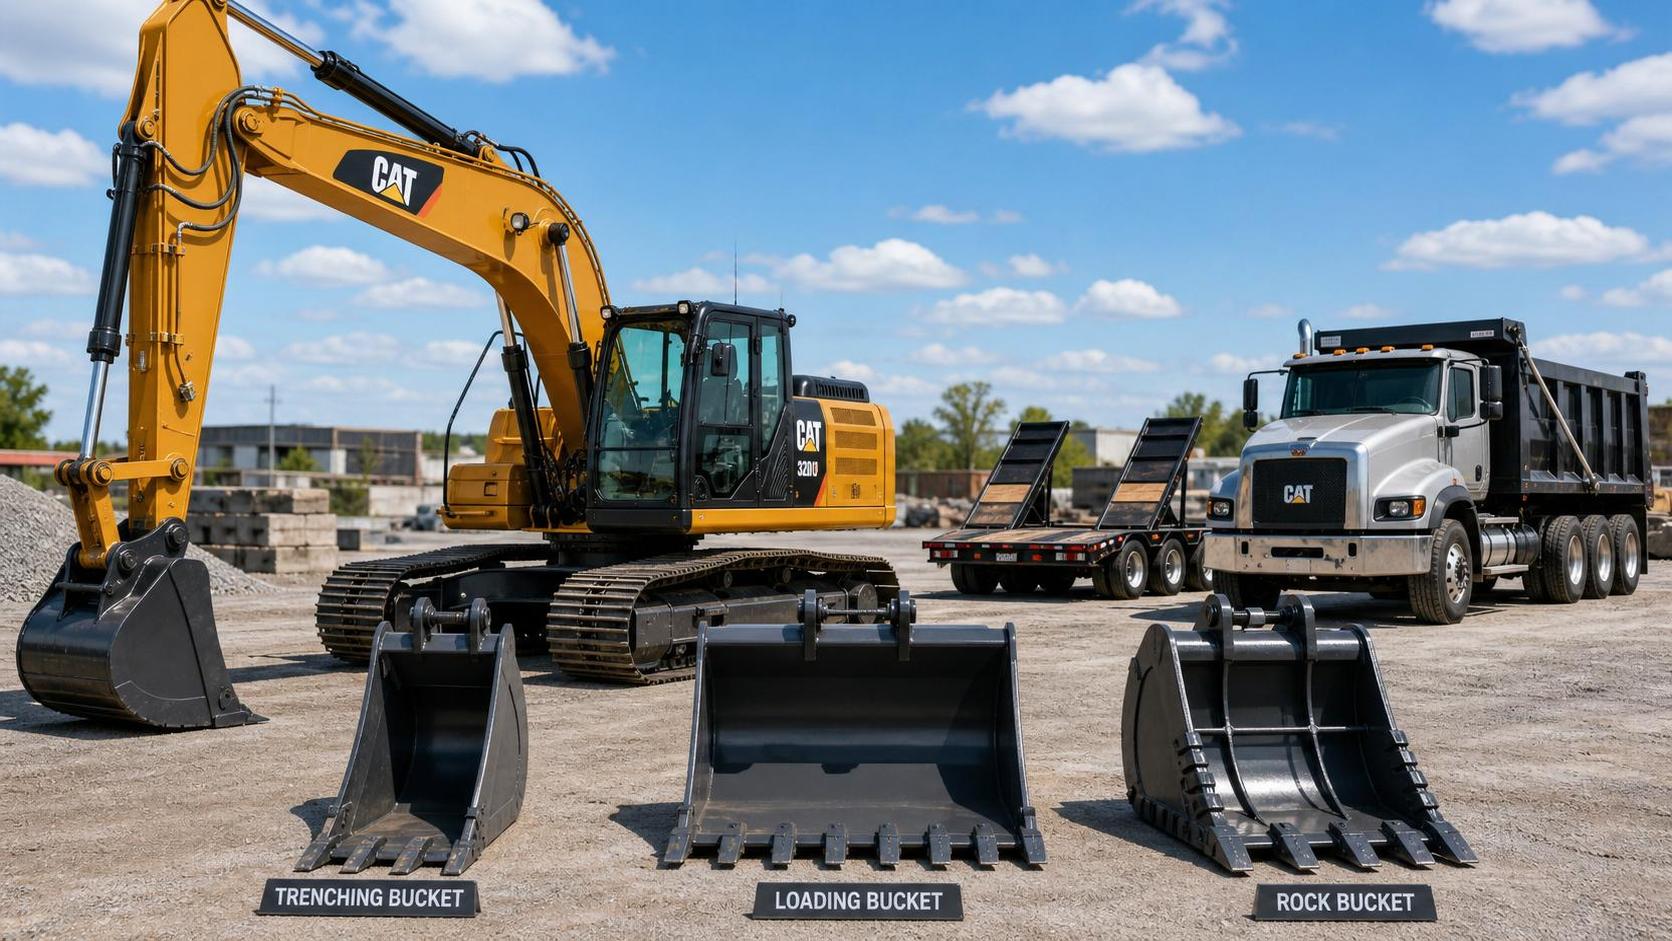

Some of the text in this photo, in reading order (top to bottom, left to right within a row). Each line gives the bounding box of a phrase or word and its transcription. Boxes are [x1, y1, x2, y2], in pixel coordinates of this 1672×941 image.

[371, 155, 418, 207] CAT
[796, 419, 822, 452] CAT
[1283, 484, 1314, 504] CAT
[275, 887, 464, 908] TRENCHING BUCKET
[775, 891, 943, 911] LOADING BUCKET
[1277, 892, 1415, 912] ROCK BUCKET
